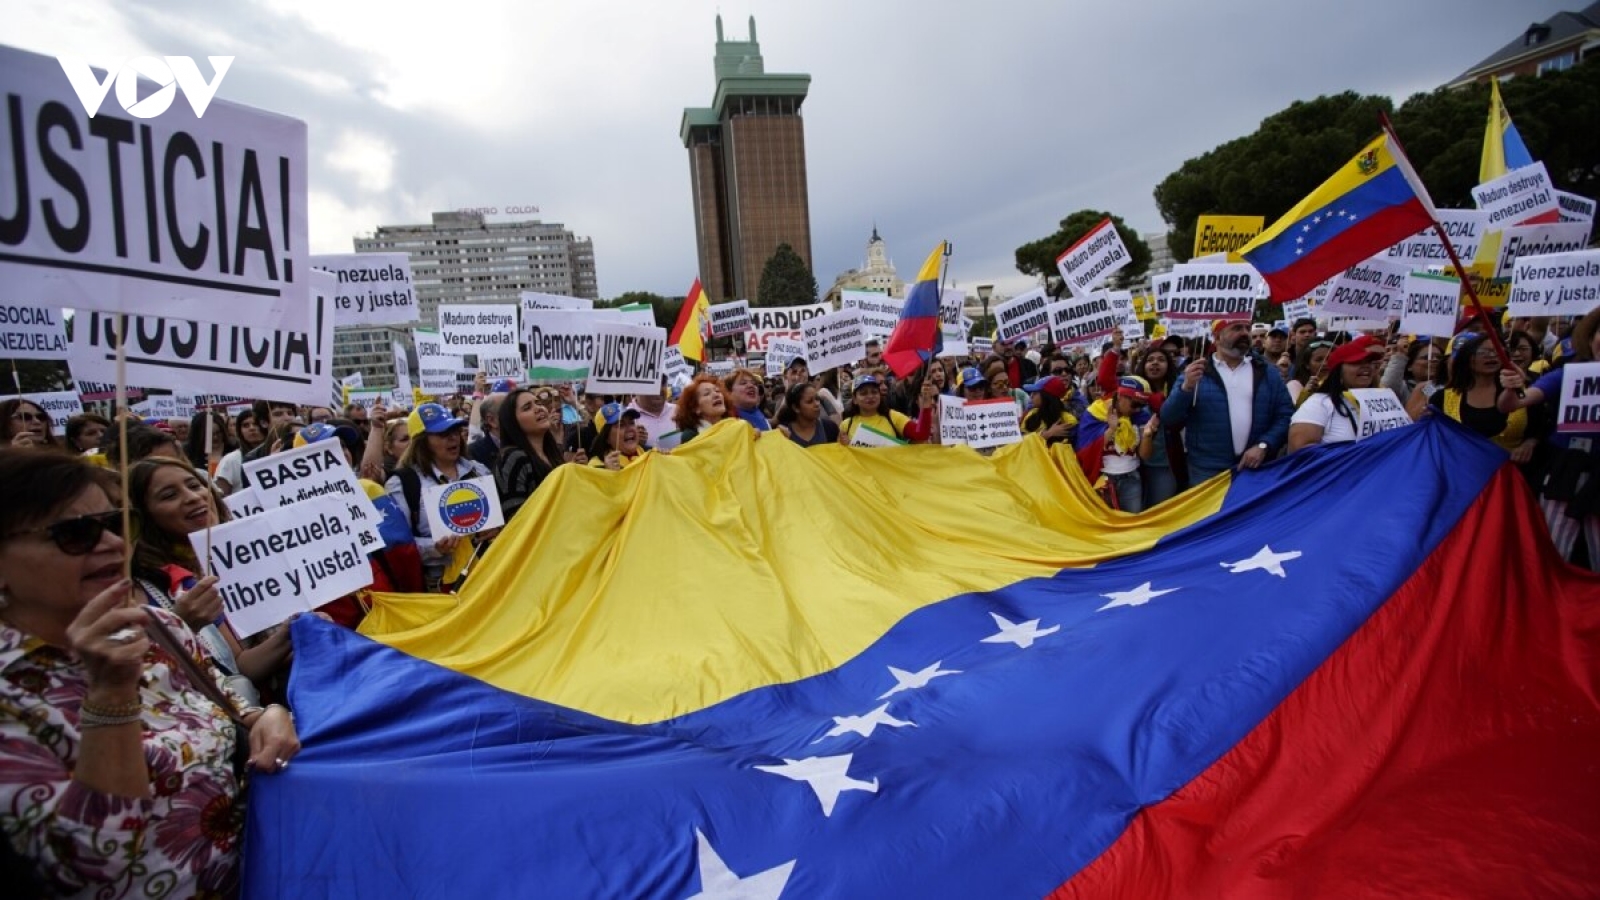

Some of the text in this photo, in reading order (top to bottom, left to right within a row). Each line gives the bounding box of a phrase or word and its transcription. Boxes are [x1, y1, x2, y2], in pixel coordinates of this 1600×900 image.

[1508, 172, 1545, 194] destruye
[505, 205, 540, 215] COLON
[1087, 229, 1116, 257] destruye
[1073, 245, 1126, 288] Venezuela!
[1176, 274, 1253, 293] ¡MADURO,
[355, 294, 365, 313] y
[369, 289, 413, 312] justa!
[1170, 297, 1254, 313] DICTADOR!
[1405, 293, 1457, 318] ¡DEMOCRACIA!
[1512, 287, 1541, 303] libre
[1543, 290, 1554, 306] y
[477, 311, 513, 328] destruye
[1055, 315, 1116, 342] DICTADOR!
[443, 331, 514, 345] Venezuela!
[804, 327, 817, 338] NO
[807, 341, 818, 351] NO
[593, 333, 664, 380] ¡JUSTICIA!
[809, 352, 819, 361] NO
[966, 413, 976, 421] NO
[967, 424, 977, 432] NO
[969, 433, 979, 441] NO
[255, 449, 341, 490] BASTA
[219, 543, 362, 613] libre y justa!
